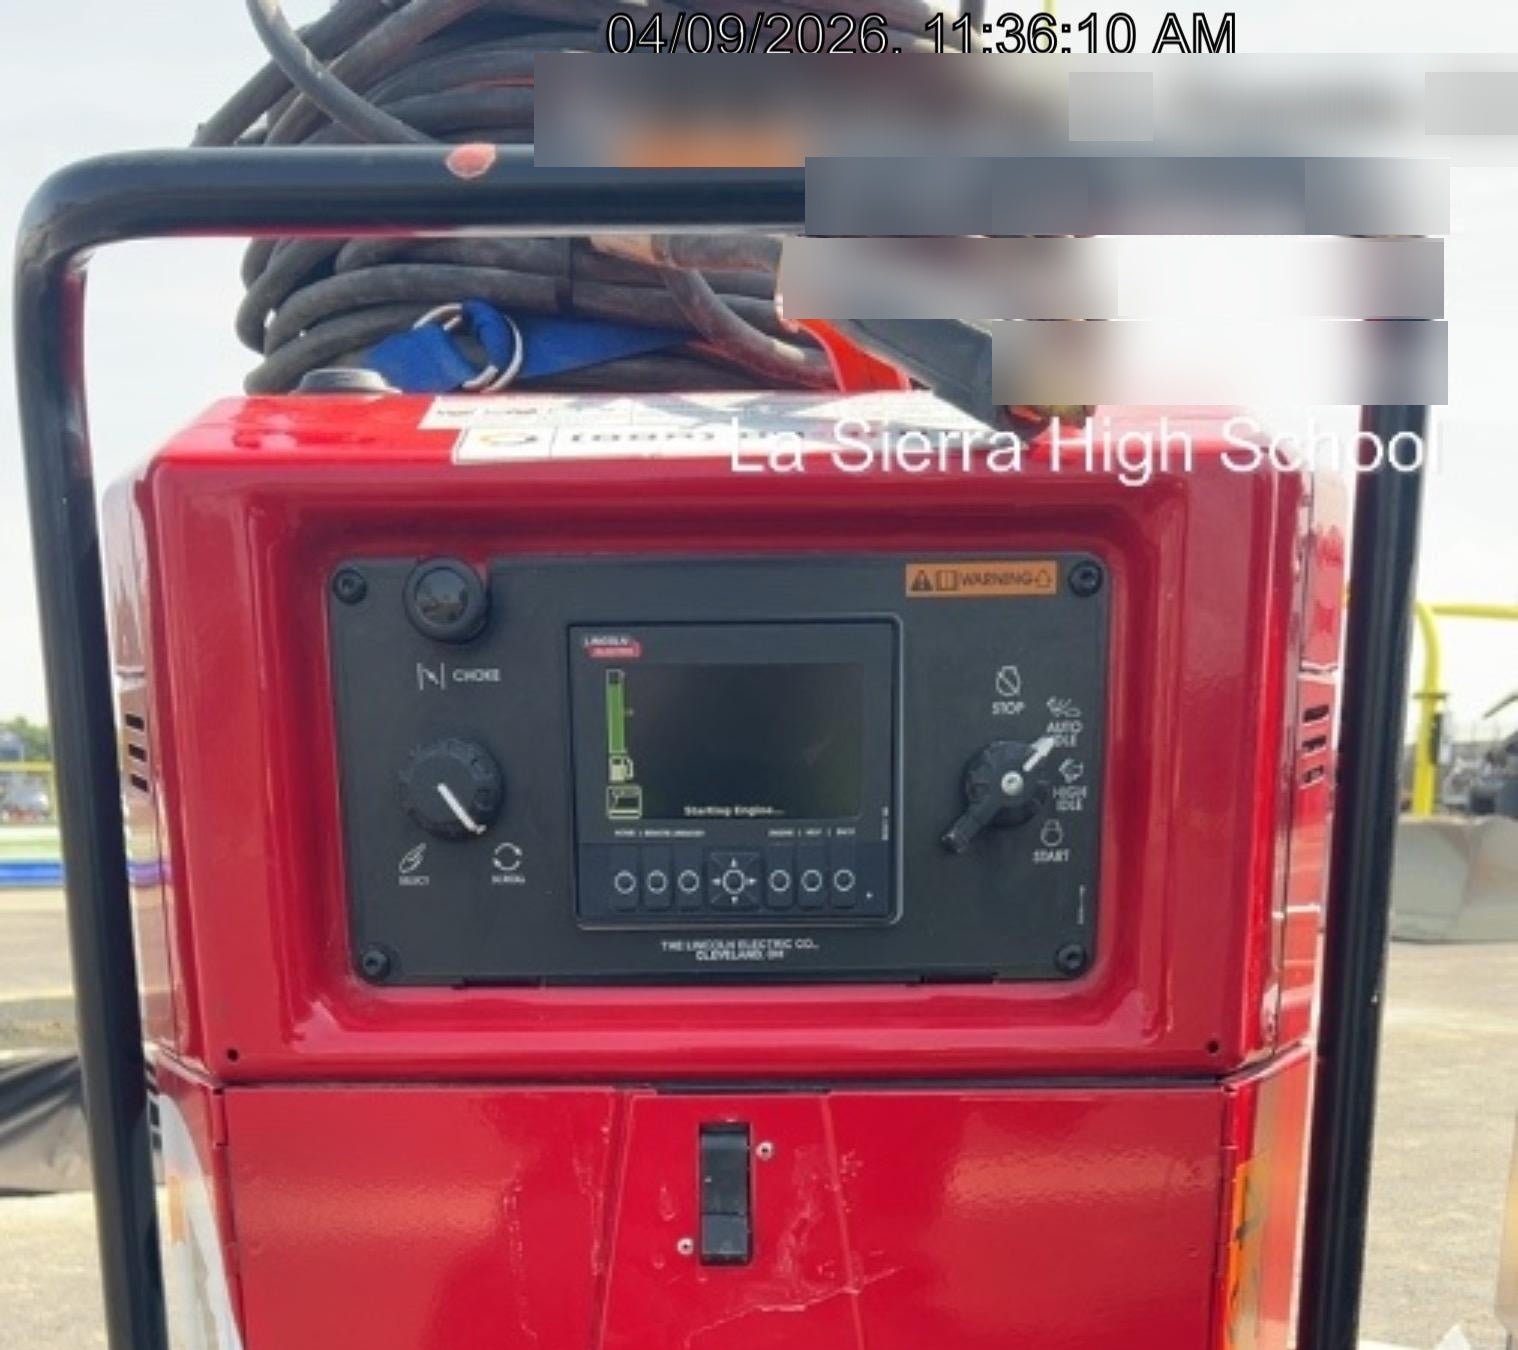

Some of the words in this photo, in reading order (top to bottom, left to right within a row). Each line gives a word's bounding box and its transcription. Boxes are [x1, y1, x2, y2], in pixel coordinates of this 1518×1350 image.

[960, 570, 1034, 587] WARNING
[453, 668, 500, 682] CHOKE
[992, 701, 1025, 715] STOP
[1047, 720, 1083, 733] AUTO
[1052, 785, 1087, 799] HIGH
[684, 806, 731, 818] Starting
[1033, 849, 1070, 862] START
[661, 940, 683, 951] THE
[686, 939, 735, 951] LINCOLN
[737, 938, 793, 950] ELECTRIC
